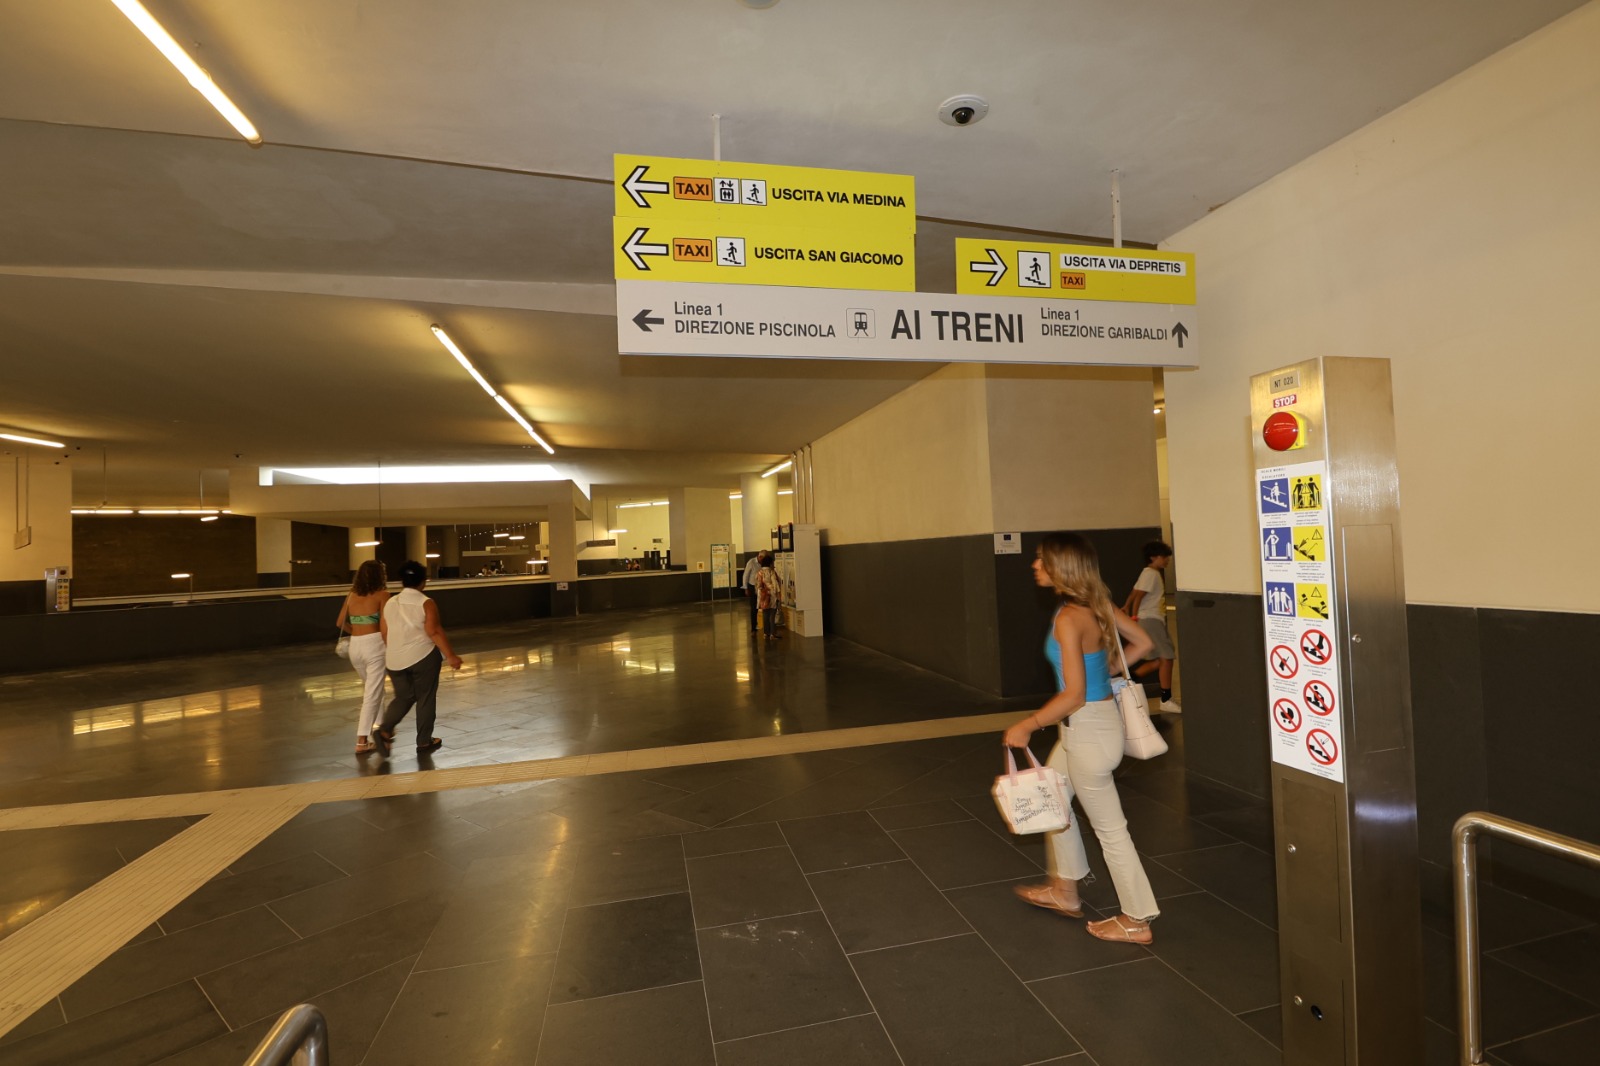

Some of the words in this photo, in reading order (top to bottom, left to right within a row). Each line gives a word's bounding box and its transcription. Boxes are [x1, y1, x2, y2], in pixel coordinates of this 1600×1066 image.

[676, 182, 710, 196] TAXI
[772, 188, 824, 202] USCITA
[827, 190, 849, 204] VIA
[853, 193, 906, 208] MEDINA
[675, 244, 709, 257] TAXI
[754, 247, 804, 261] USCITA
[808, 249, 836, 263] SAN
[840, 251, 904, 266] GIACOMO
[1064, 255, 1106, 269] USCITA
[1109, 257, 1126, 270] VIA
[1129, 259, 1181, 274] DEPRETIS
[1062, 276, 1084, 287] TAXI
[674, 301, 712, 316] Linea
[717, 303, 723, 317] 1
[1041, 307, 1071, 321] Linea
[1074, 309, 1080, 321] 1
[675, 320, 755, 336] DIREZIONE
[760, 322, 836, 339] PISCINOLA
[890, 309, 921, 341] AI
[931, 310, 1024, 344] TRENI
[1041, 323, 1105, 339] DIREZIONE
[1108, 325, 1168, 342] GARIBALDI
[1274, 395, 1295, 408] STOP
